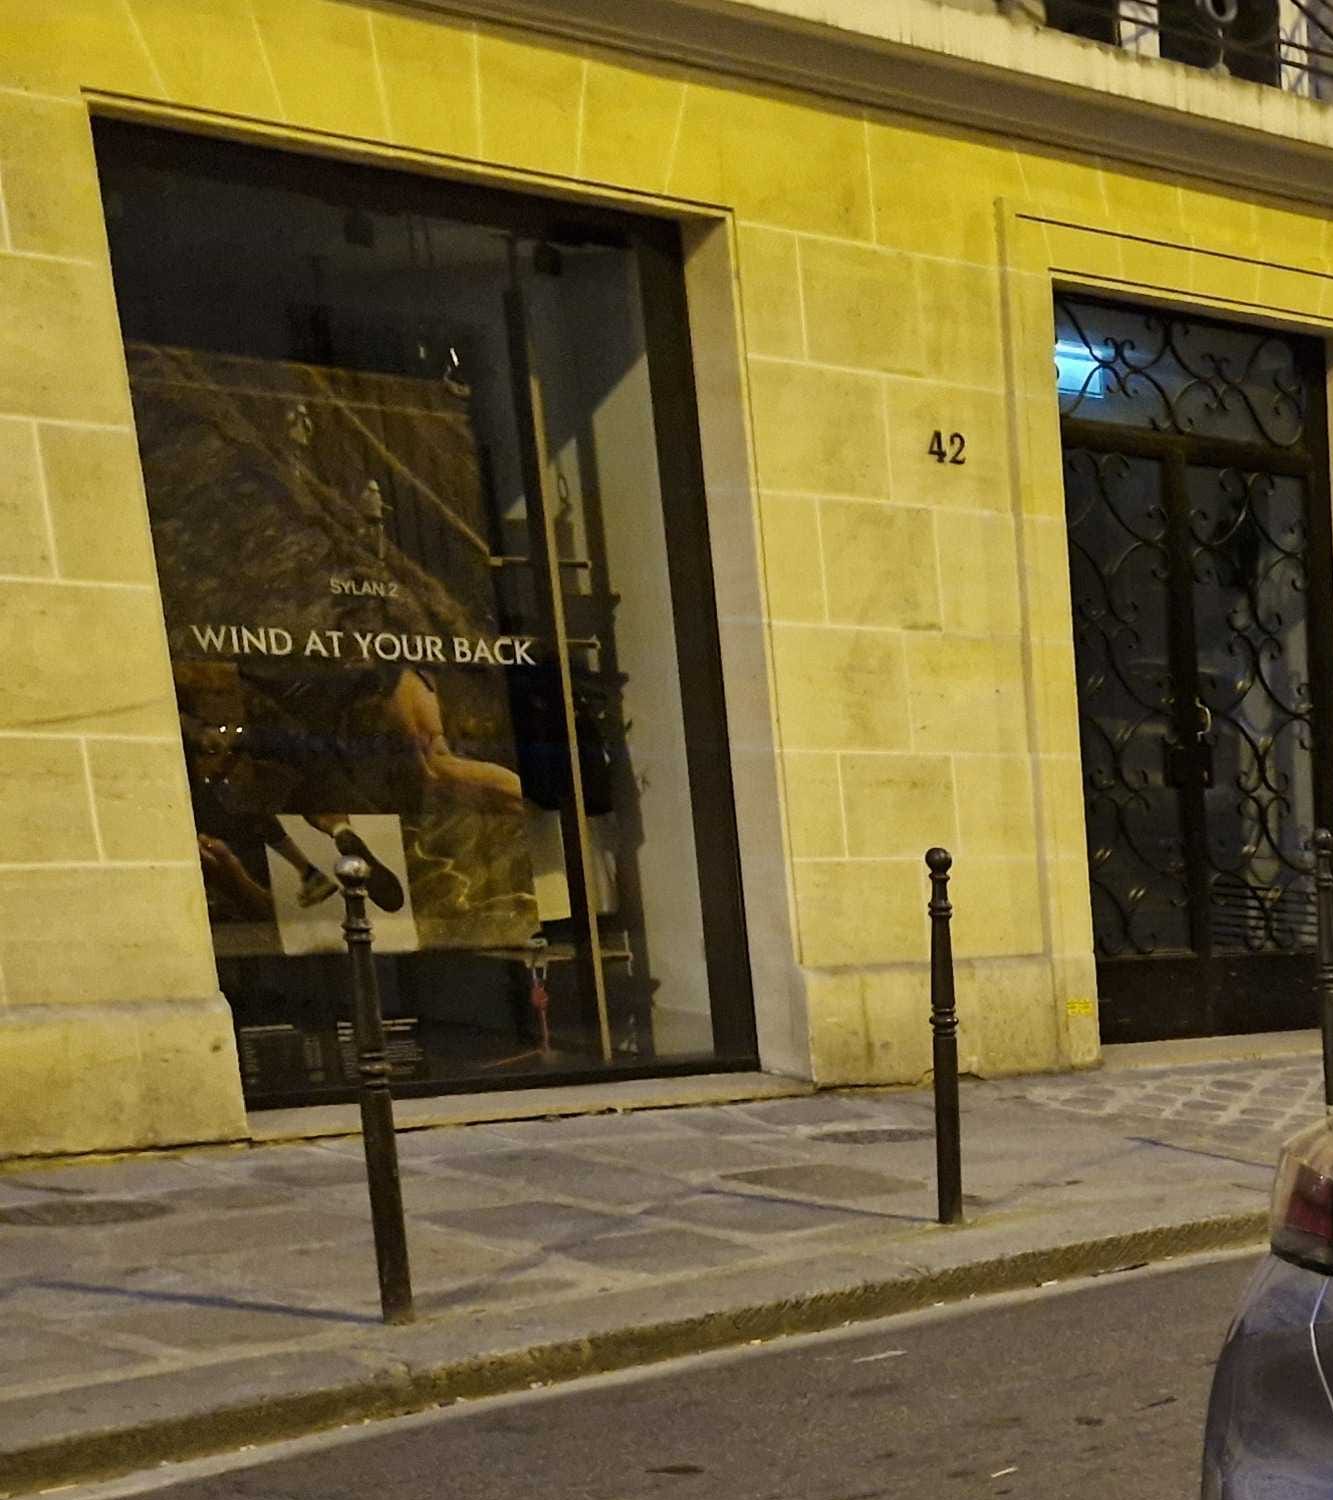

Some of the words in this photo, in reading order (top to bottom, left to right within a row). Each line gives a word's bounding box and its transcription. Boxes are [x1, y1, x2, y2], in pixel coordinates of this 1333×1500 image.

[927, 429, 967, 465] 42
[330, 577, 386, 597] SYLAN
[388, 584, 399, 598] 2
[190, 624, 294, 656] WIND
[303, 630, 344, 658] AT
[352, 631, 448, 663] YOUR
[453, 636, 537, 667] BACK
